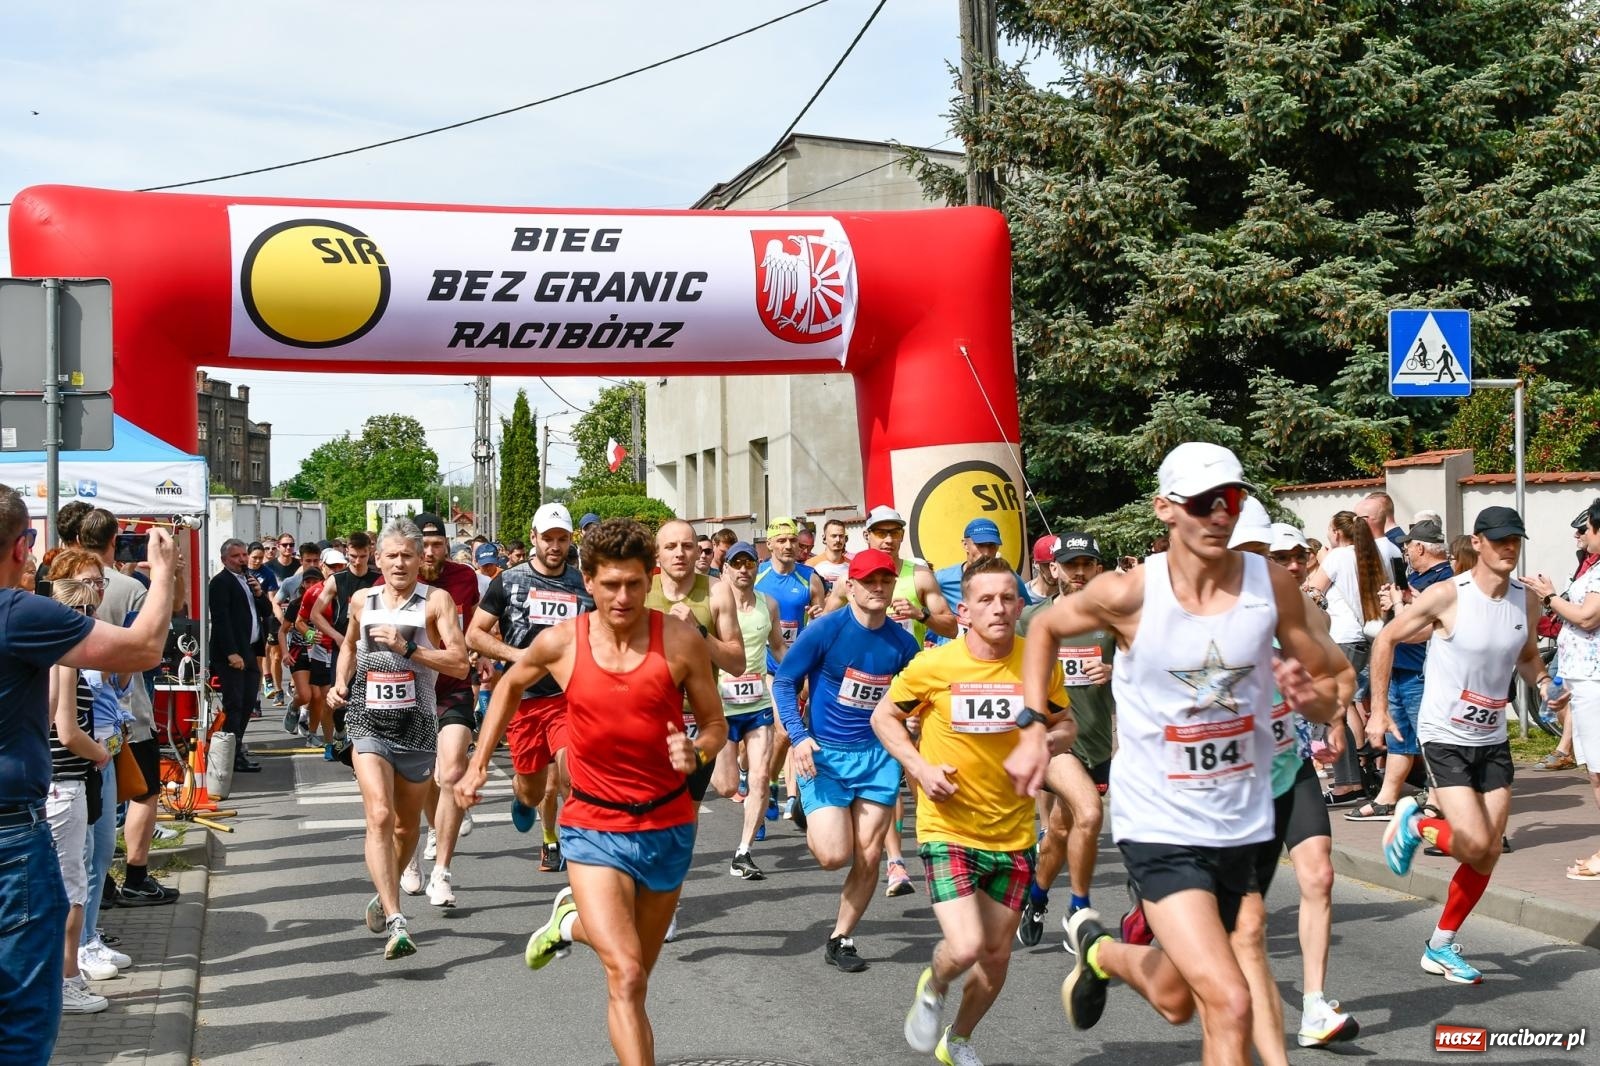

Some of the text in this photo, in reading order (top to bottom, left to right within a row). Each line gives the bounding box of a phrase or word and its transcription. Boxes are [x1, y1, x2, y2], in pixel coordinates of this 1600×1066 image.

[511, 227, 622, 252] BIEG
[312, 238, 386, 264] SIR
[427, 269, 708, 302] BEZ GRANIC
[447, 314, 685, 348] RACIBÓRZ
[155, 487, 182, 495] MITKO
[972, 483, 1021, 511] SIR
[1066, 538, 1088, 548] ciele
[540, 601, 568, 617] 170
[375, 684, 407, 700] 135
[734, 682, 754, 696] 121
[851, 682, 884, 701] 155
[965, 698, 1011, 719] 143
[1463, 705, 1499, 725] 236
[1184, 739, 1240, 771] 184
